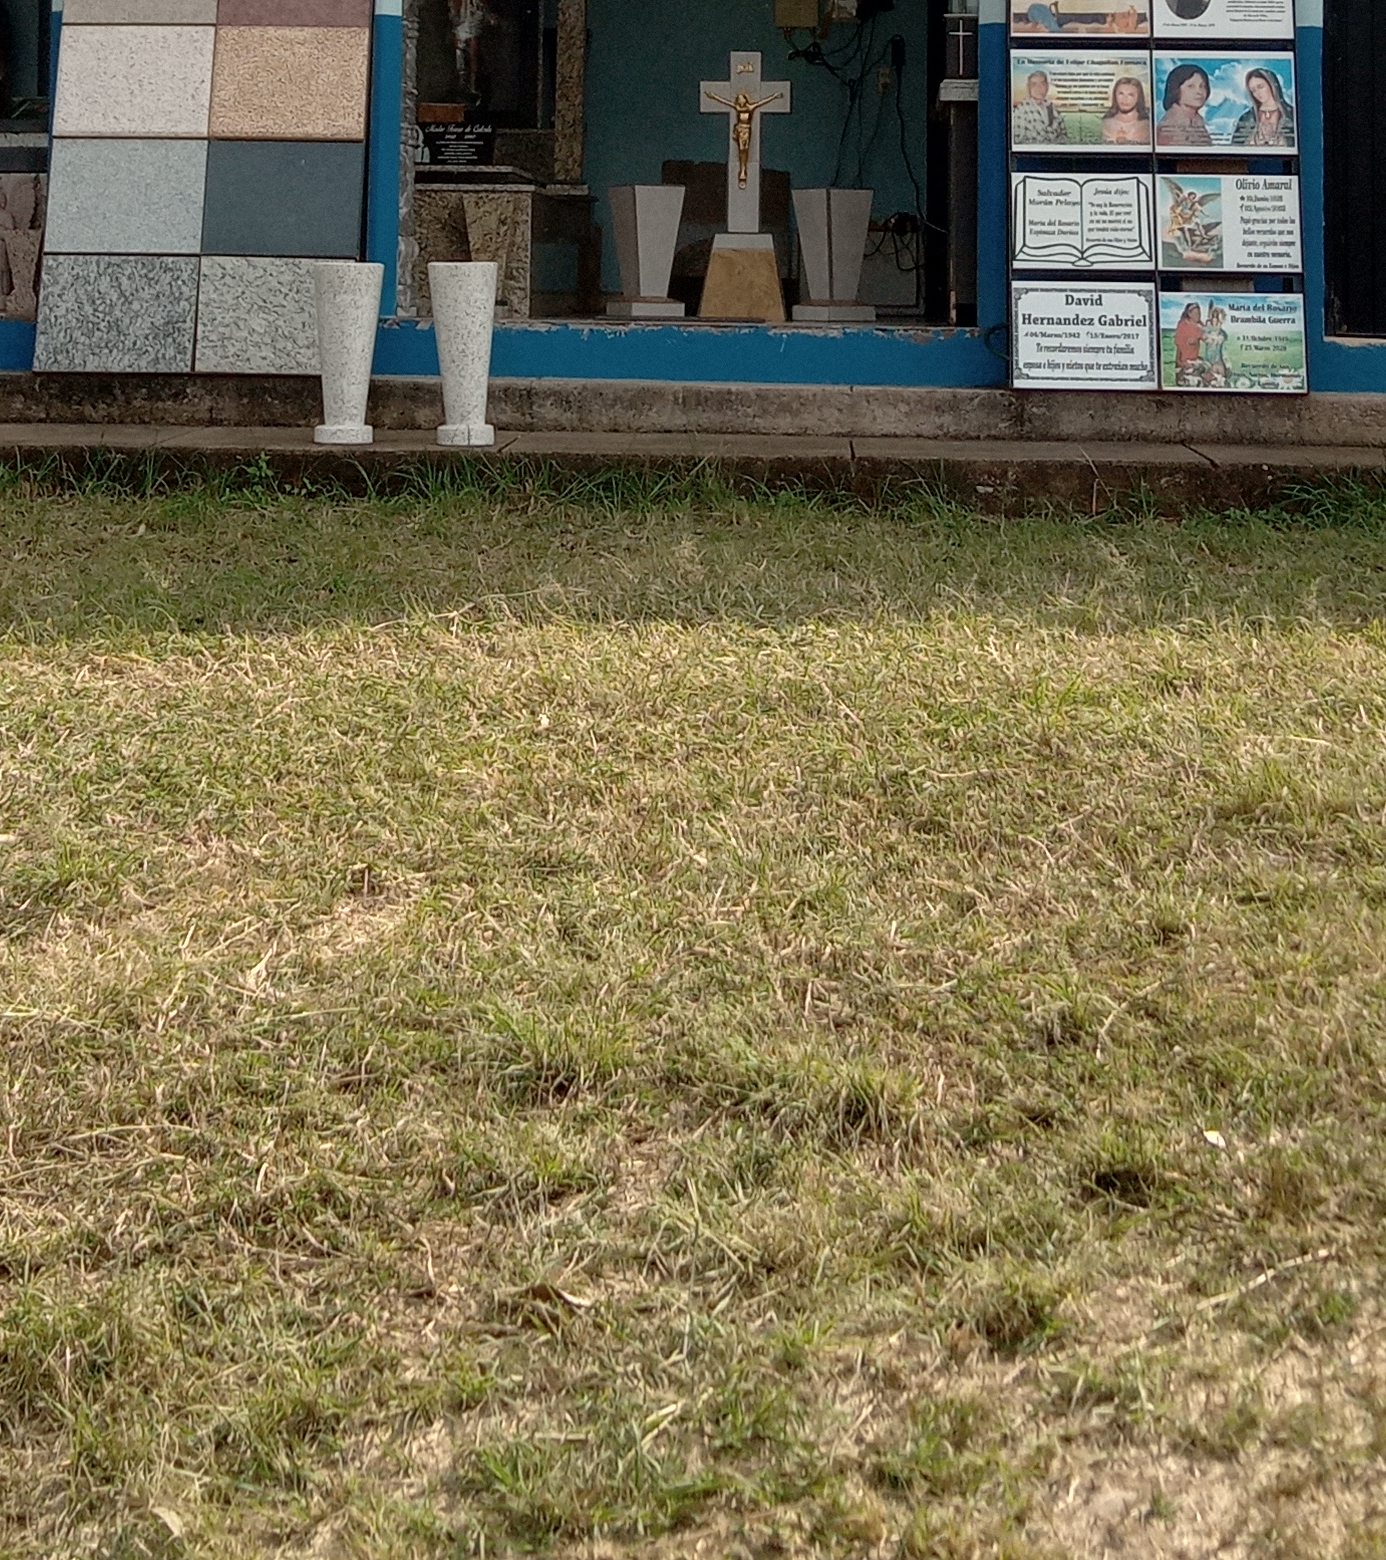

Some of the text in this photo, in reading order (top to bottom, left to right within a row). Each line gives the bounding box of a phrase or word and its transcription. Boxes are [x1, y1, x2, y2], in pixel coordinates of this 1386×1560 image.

[1065, 294, 1103, 307] David
[1021, 313, 1147, 327] Hernandez Gabriel
